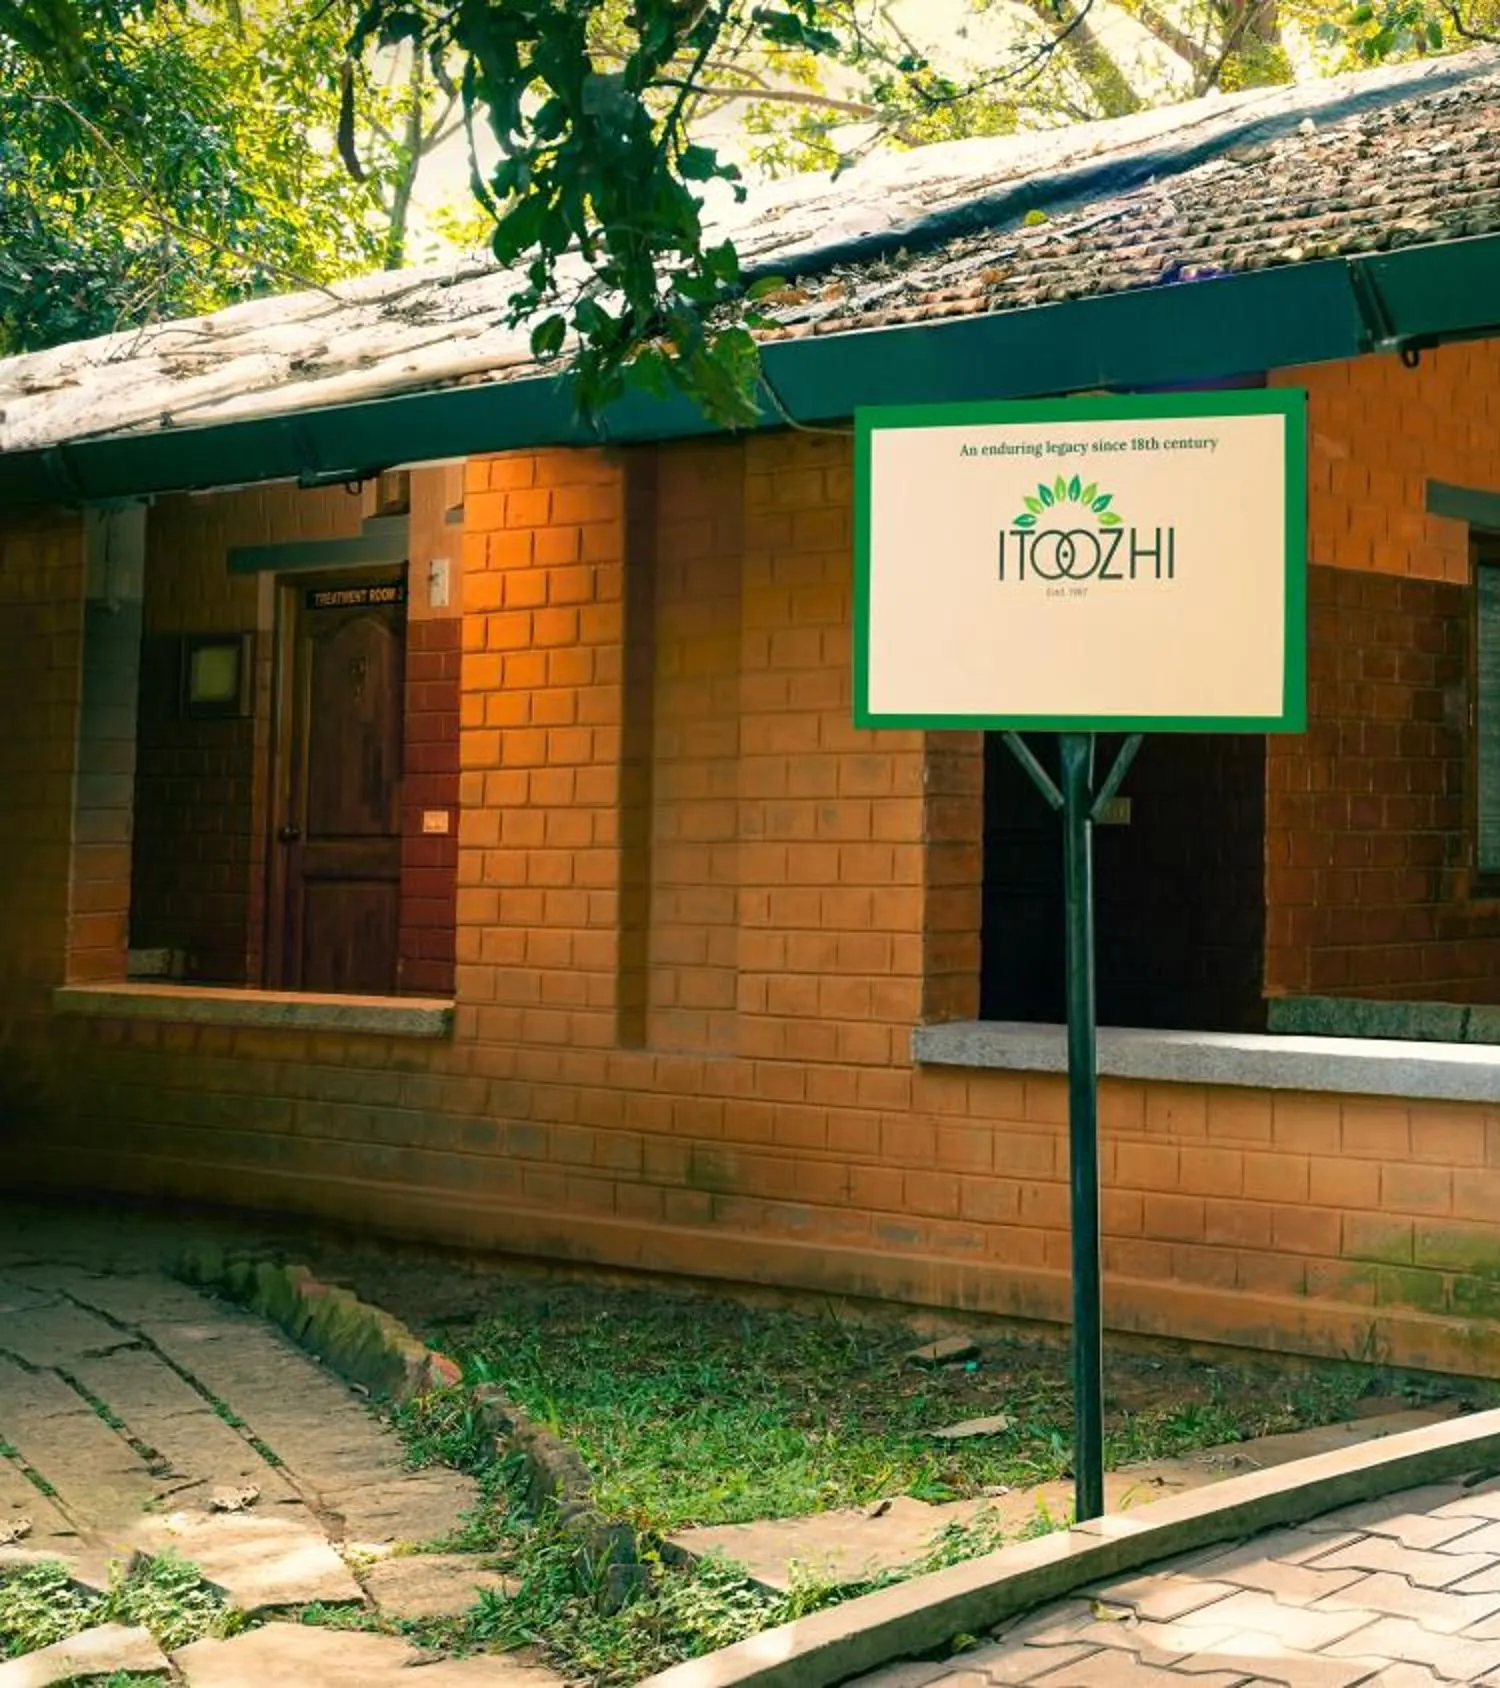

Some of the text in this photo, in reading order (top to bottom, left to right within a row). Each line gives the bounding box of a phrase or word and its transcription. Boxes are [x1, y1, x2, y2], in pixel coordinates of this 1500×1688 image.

[960, 436, 1219, 458] An enduring legacy since 18th century
[998, 527, 1174, 581] ITOOZHI
[315, 590, 368, 607] TREATMENT
[369, 587, 396, 601] ROOM
